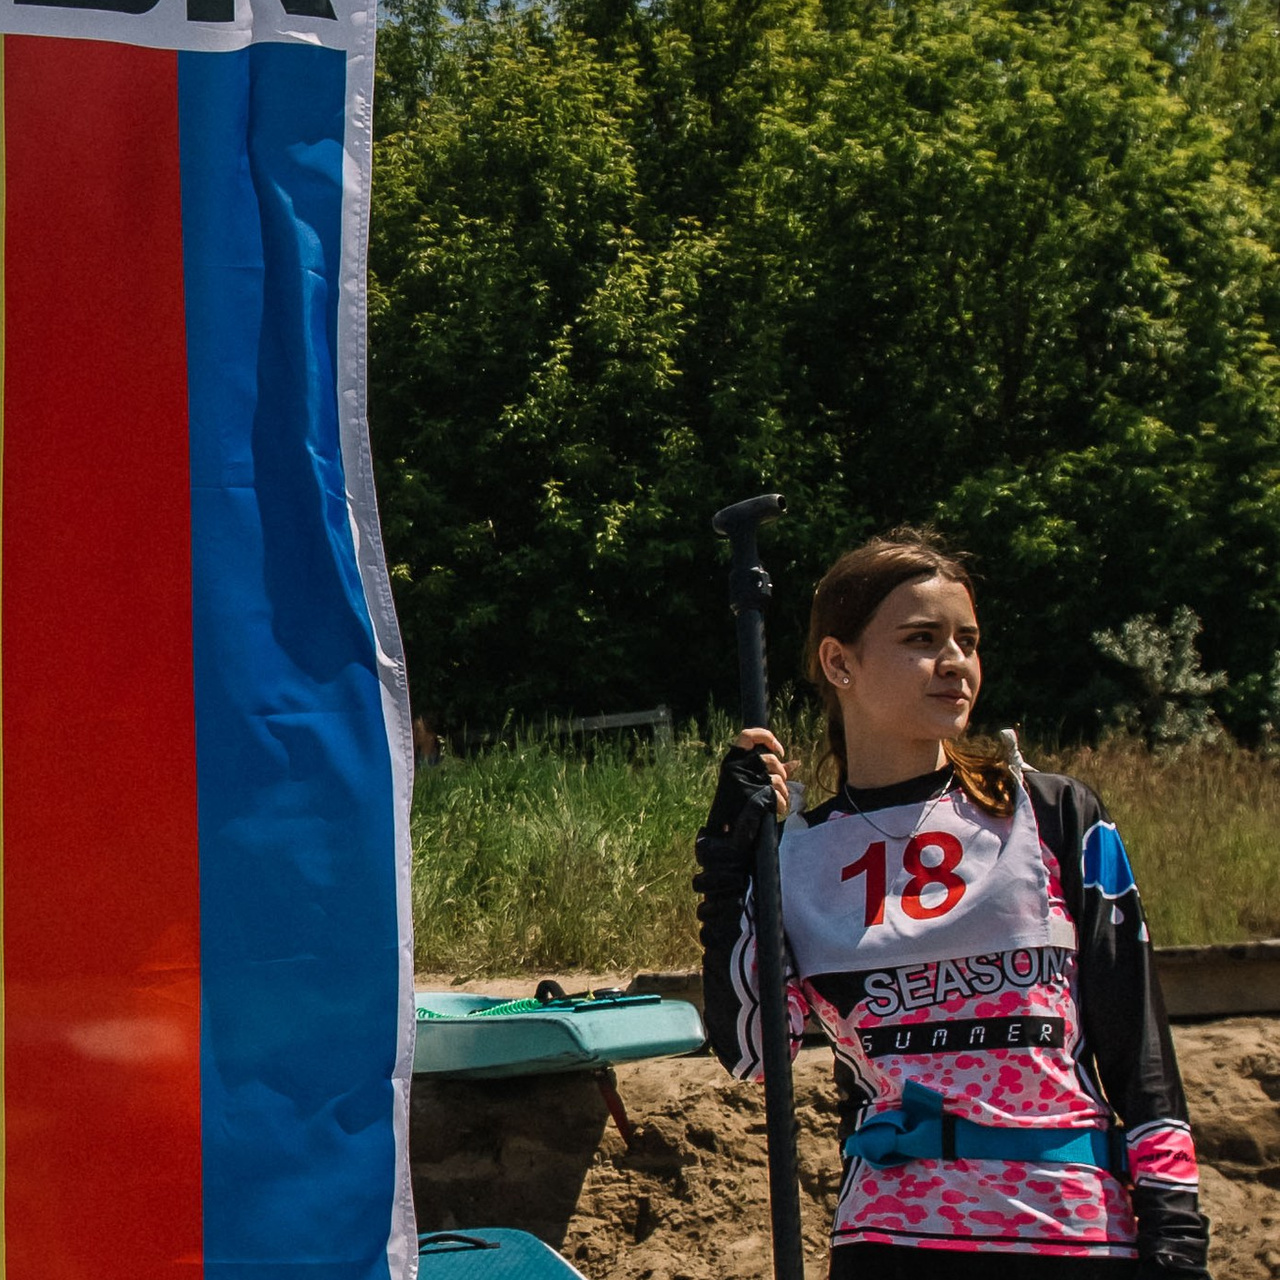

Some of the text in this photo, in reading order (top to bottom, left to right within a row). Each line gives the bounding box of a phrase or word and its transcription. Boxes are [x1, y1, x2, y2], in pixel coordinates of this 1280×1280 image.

[841, 831, 966, 927] 18
[863, 946, 1066, 1017] SEASON
[862, 1023, 1053, 1053] SUMMER
